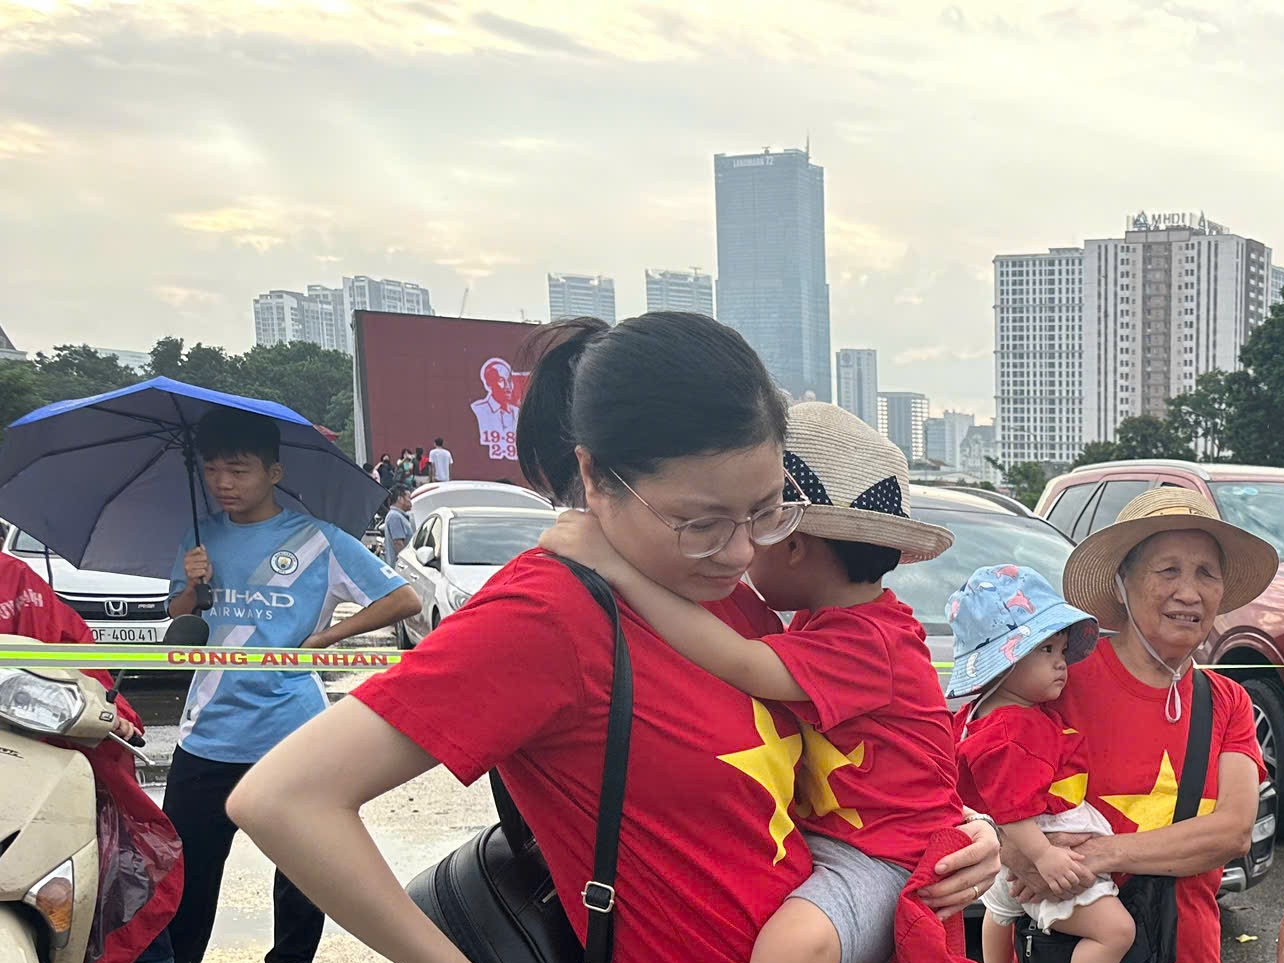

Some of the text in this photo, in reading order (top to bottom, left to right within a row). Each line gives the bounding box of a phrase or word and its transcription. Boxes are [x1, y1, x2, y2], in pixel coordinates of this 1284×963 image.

[211, 588, 295, 608] TIHAD
[209, 606, 273, 620] AIRWAYS
[91, 628, 154, 642] 0F-400.41
[167, 648, 248, 666] CÔNG
[260, 652, 299, 666] AN
